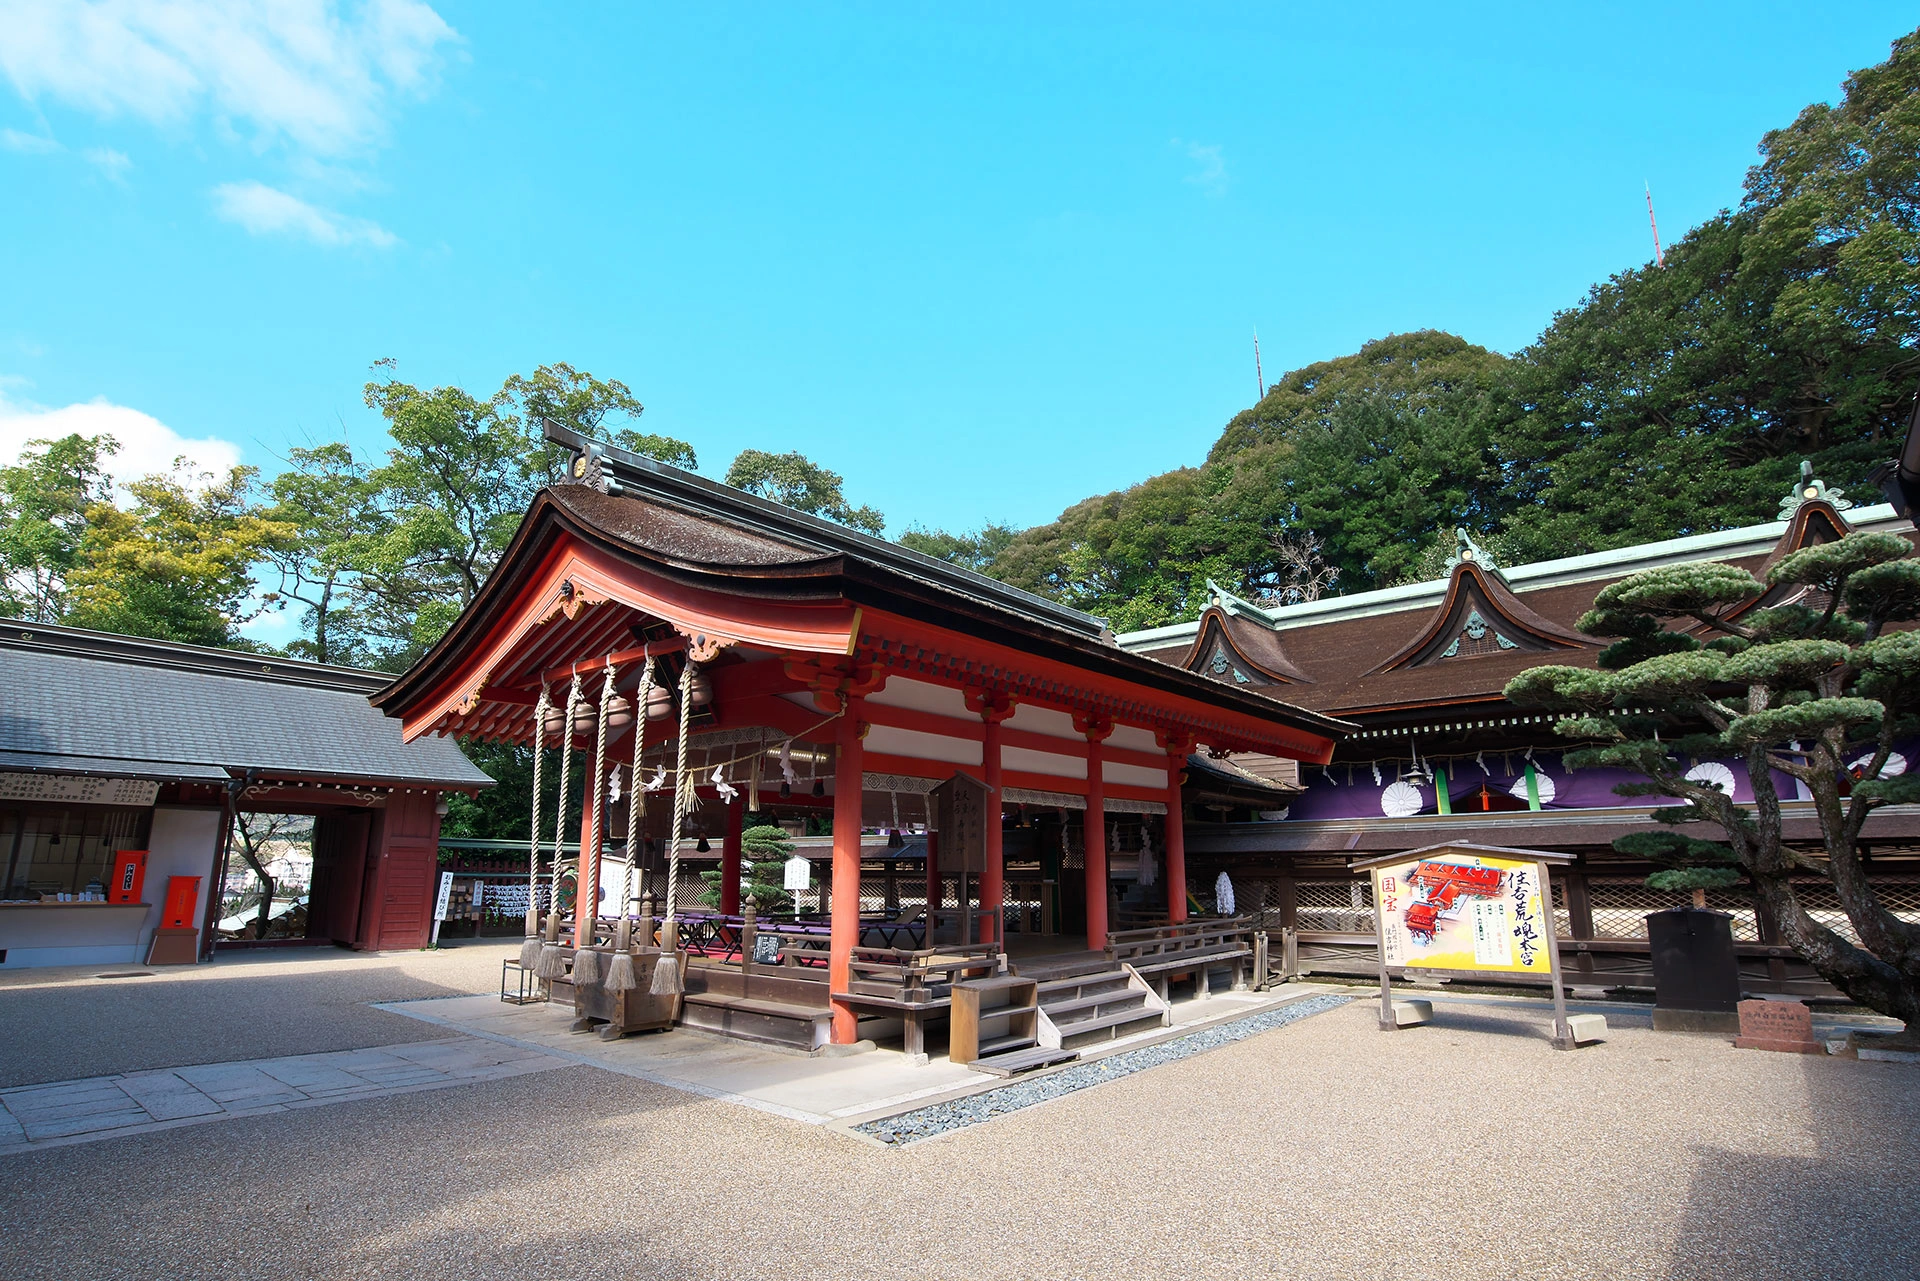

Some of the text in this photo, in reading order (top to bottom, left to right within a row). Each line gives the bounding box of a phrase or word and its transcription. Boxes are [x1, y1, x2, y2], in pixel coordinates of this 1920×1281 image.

[124, 865, 134, 889] おみくじ
[437, 874, 451, 917] おみくじ結び所
[1382, 877, 1397, 912] 国宝
[1385, 928, 1395, 960] 住吉神社
